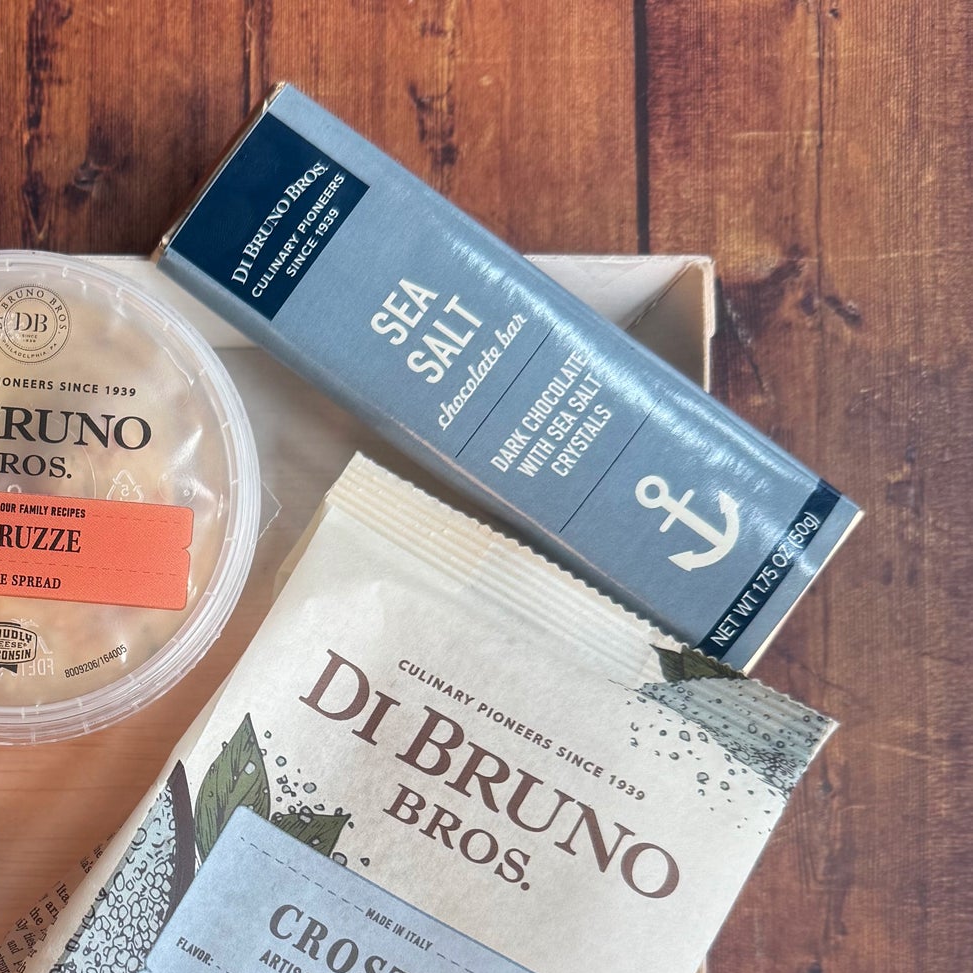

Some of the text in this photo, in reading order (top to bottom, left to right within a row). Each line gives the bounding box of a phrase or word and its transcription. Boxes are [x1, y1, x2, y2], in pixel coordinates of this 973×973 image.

[231, 162, 329, 285] DI BRUNO BROS.
[251, 172, 345, 298] CULINARY PIONEERS
[285, 208, 340, 278] SINCE 1939
[1, 288, 45, 310] BRUNO
[13, 312, 48, 333] DB
[370, 278, 439, 346] SEA
[407, 294, 483, 384] SALT
[438, 313, 528, 431] chocolate bar
[59, 382, 99, 394] SINCE
[105, 385, 137, 397] 1939
[490, 349, 590, 472] DARK CHOCOLATE
[516, 372, 603, 478] WITH SEA SALT
[550, 404, 613, 477] CRYSTALS
[0, 503, 16, 514] OUR
[19, 504, 48, 517] FAMILY
[51, 507, 86, 519] RECIPES
[11, 575, 62, 590] SPREAD
[710, 511, 821, 647] NET WT 1.75 OZ (50g)
[64, 644, 128, 679] 8009206/164005
[398, 659, 646, 801] CULINARY PIONEERS SINCE 1939
[299, 649, 680, 899] DI BRUNO
[383, 783, 531, 891] BROS.
[176, 937, 214, 967] FLAVOR:
[365, 907, 433, 951] MADE IN ITALY
